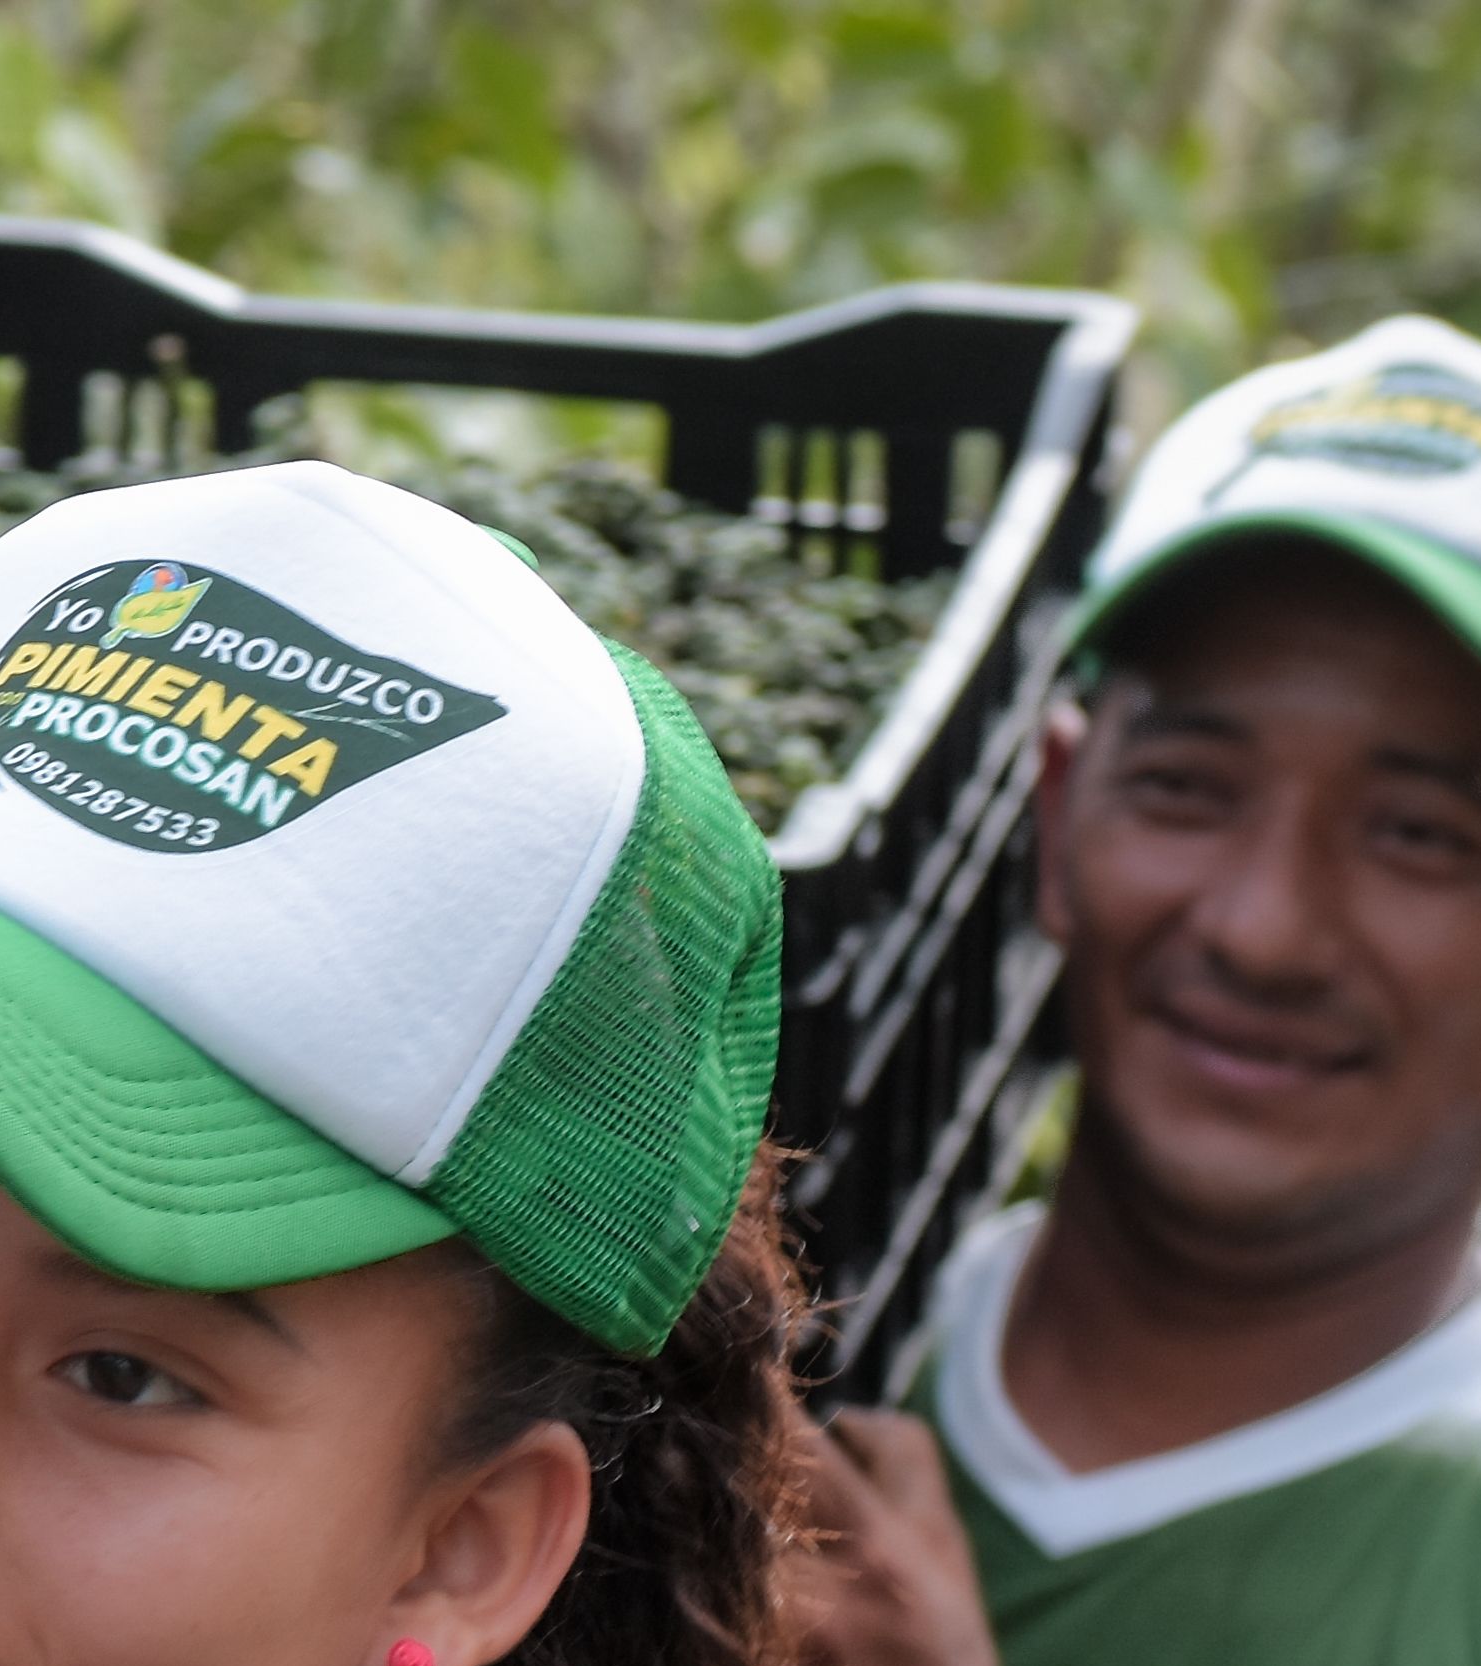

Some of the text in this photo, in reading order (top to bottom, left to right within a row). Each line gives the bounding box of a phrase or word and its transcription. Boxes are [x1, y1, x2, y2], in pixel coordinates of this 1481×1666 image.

[171, 621, 444, 726] PRODUZCO
[2, 742, 220, 847] 0981287533
[8, 692, 297, 828] PROCOSAN
